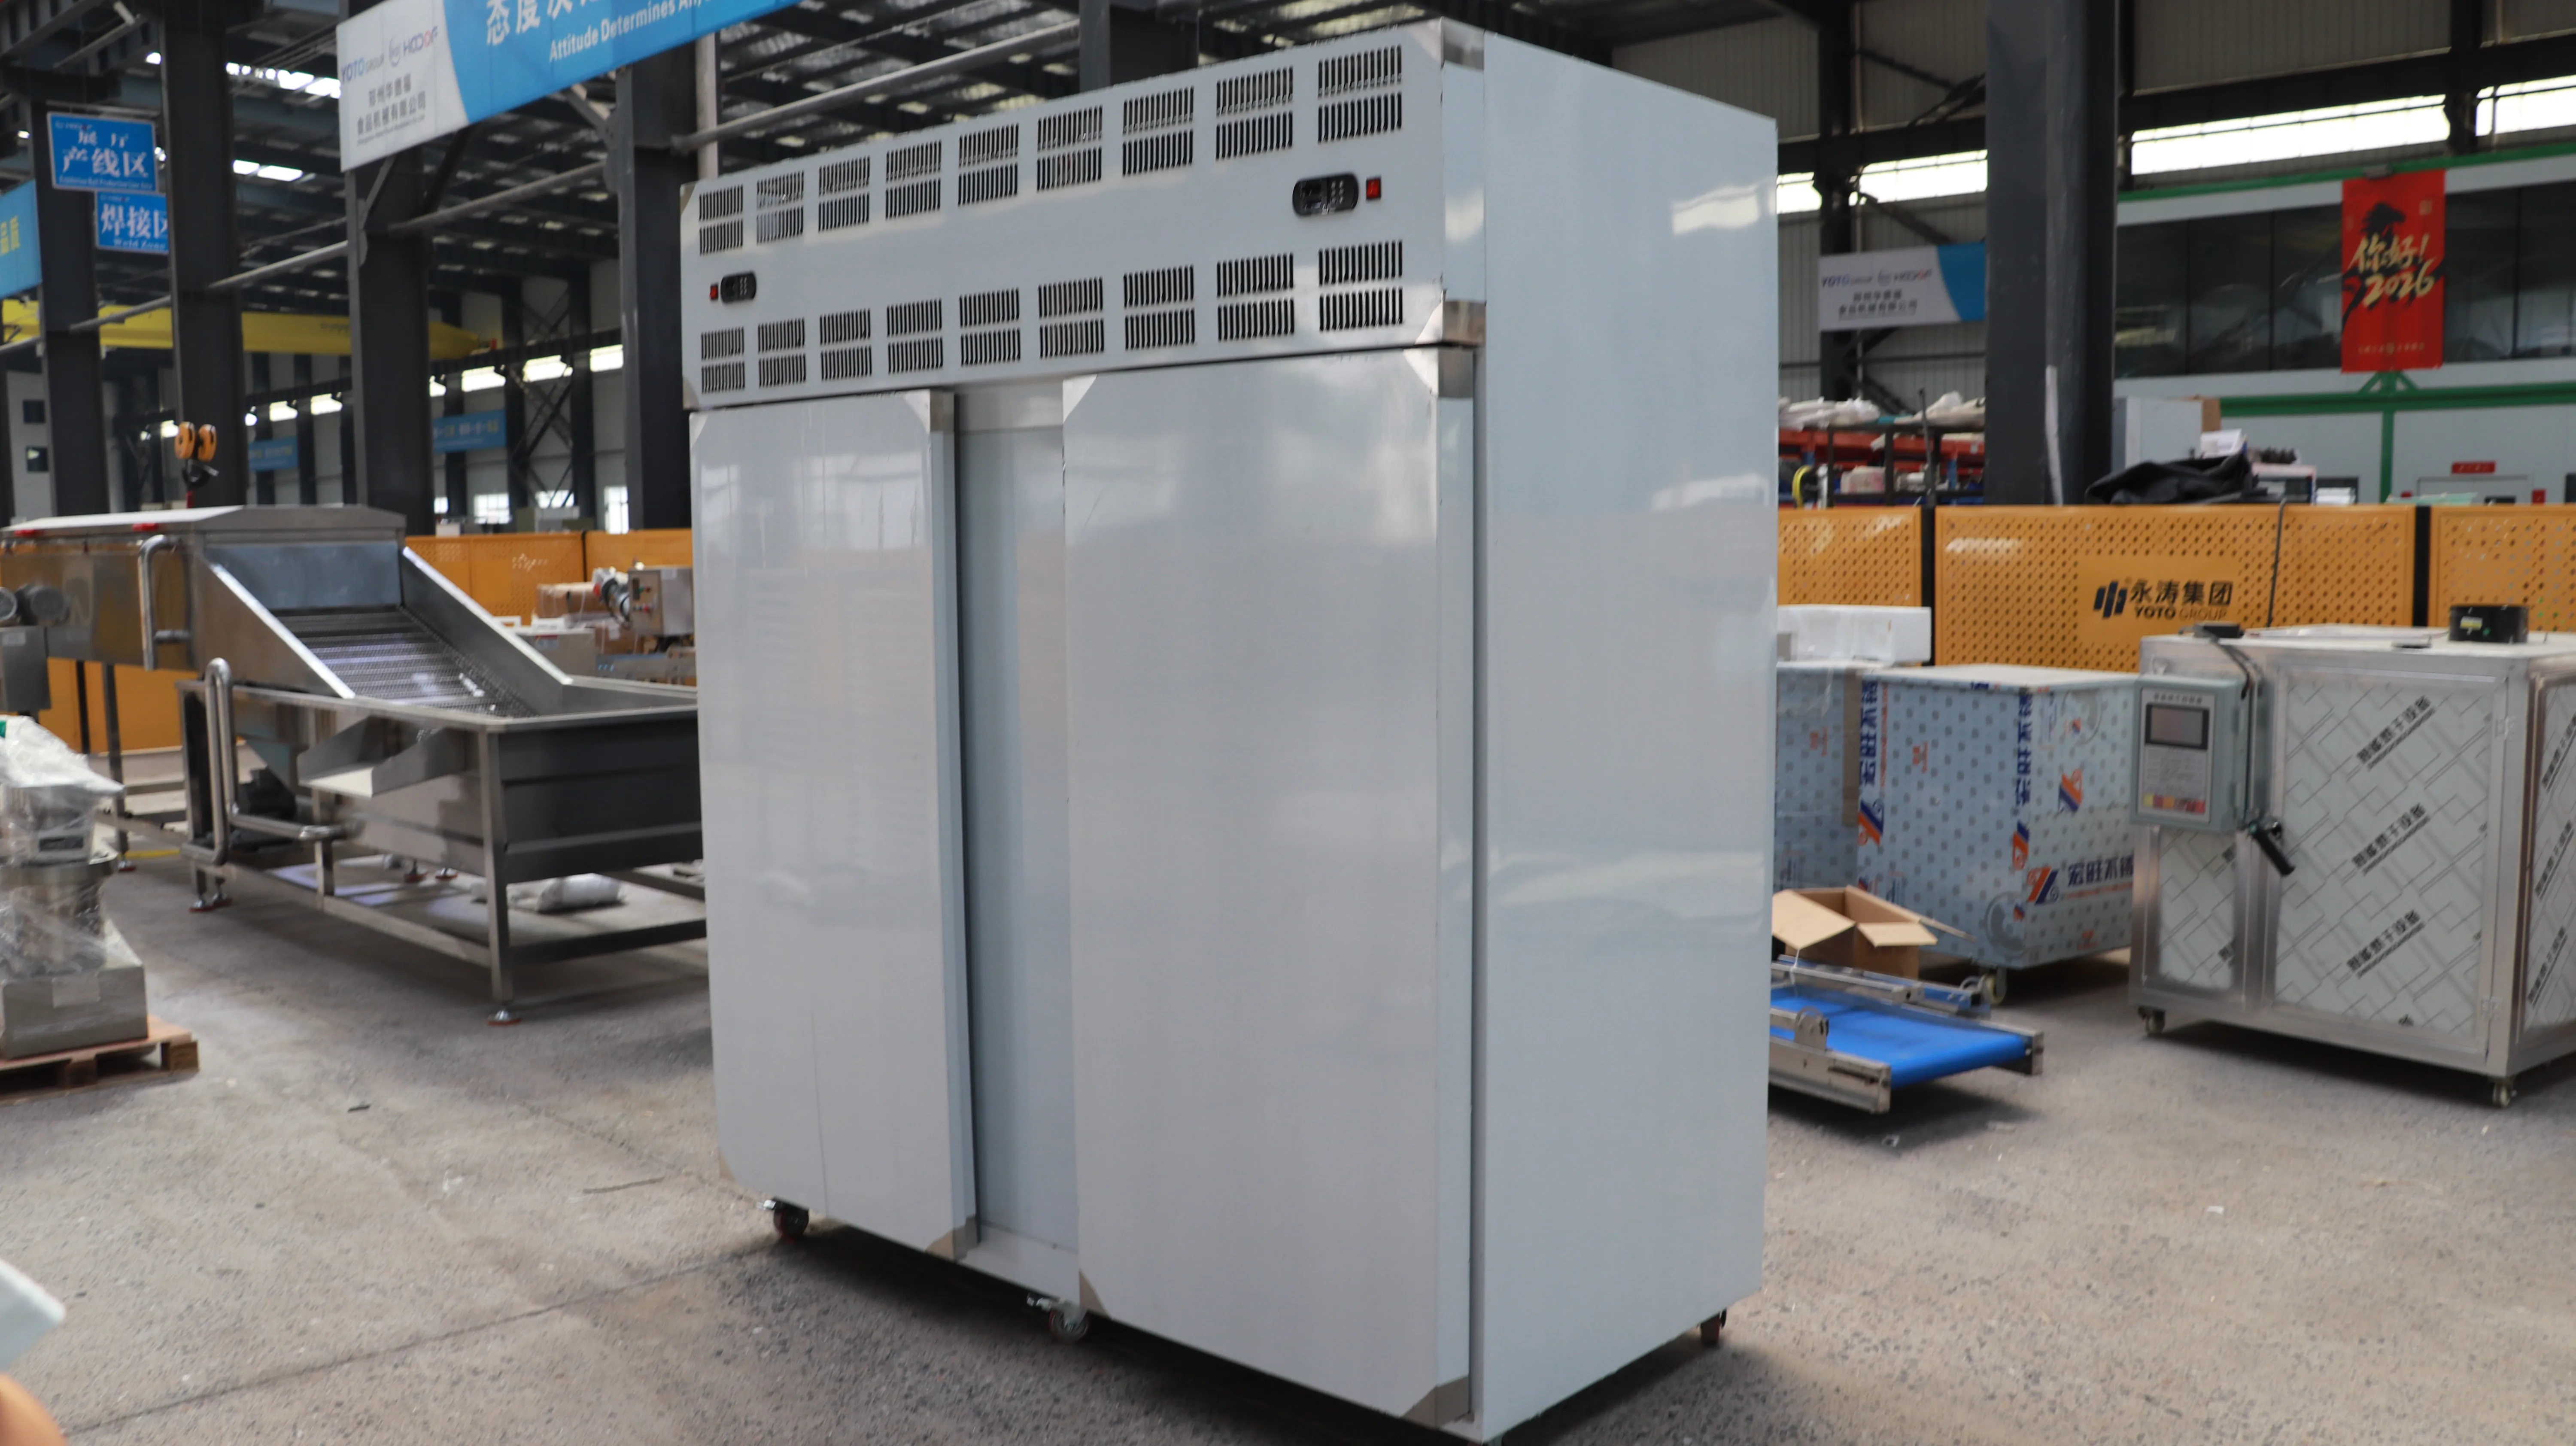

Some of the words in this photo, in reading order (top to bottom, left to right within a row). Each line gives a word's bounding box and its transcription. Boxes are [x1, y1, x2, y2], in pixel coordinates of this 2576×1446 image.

[486, 0, 600, 46] 态度
[550, 24, 598, 62] Attitude
[601, 1, 675, 42] Determines
[340, 57, 365, 85] YOTO
[61, 145, 149, 178] 产线区
[100, 204, 168, 239] 焊接区
[2362, 256, 2438, 308] 2026
[2130, 578, 2233, 606] 永涛集团
[2134, 605, 2177, 620] YOTO
[2178, 606, 2228, 621] GROUP
